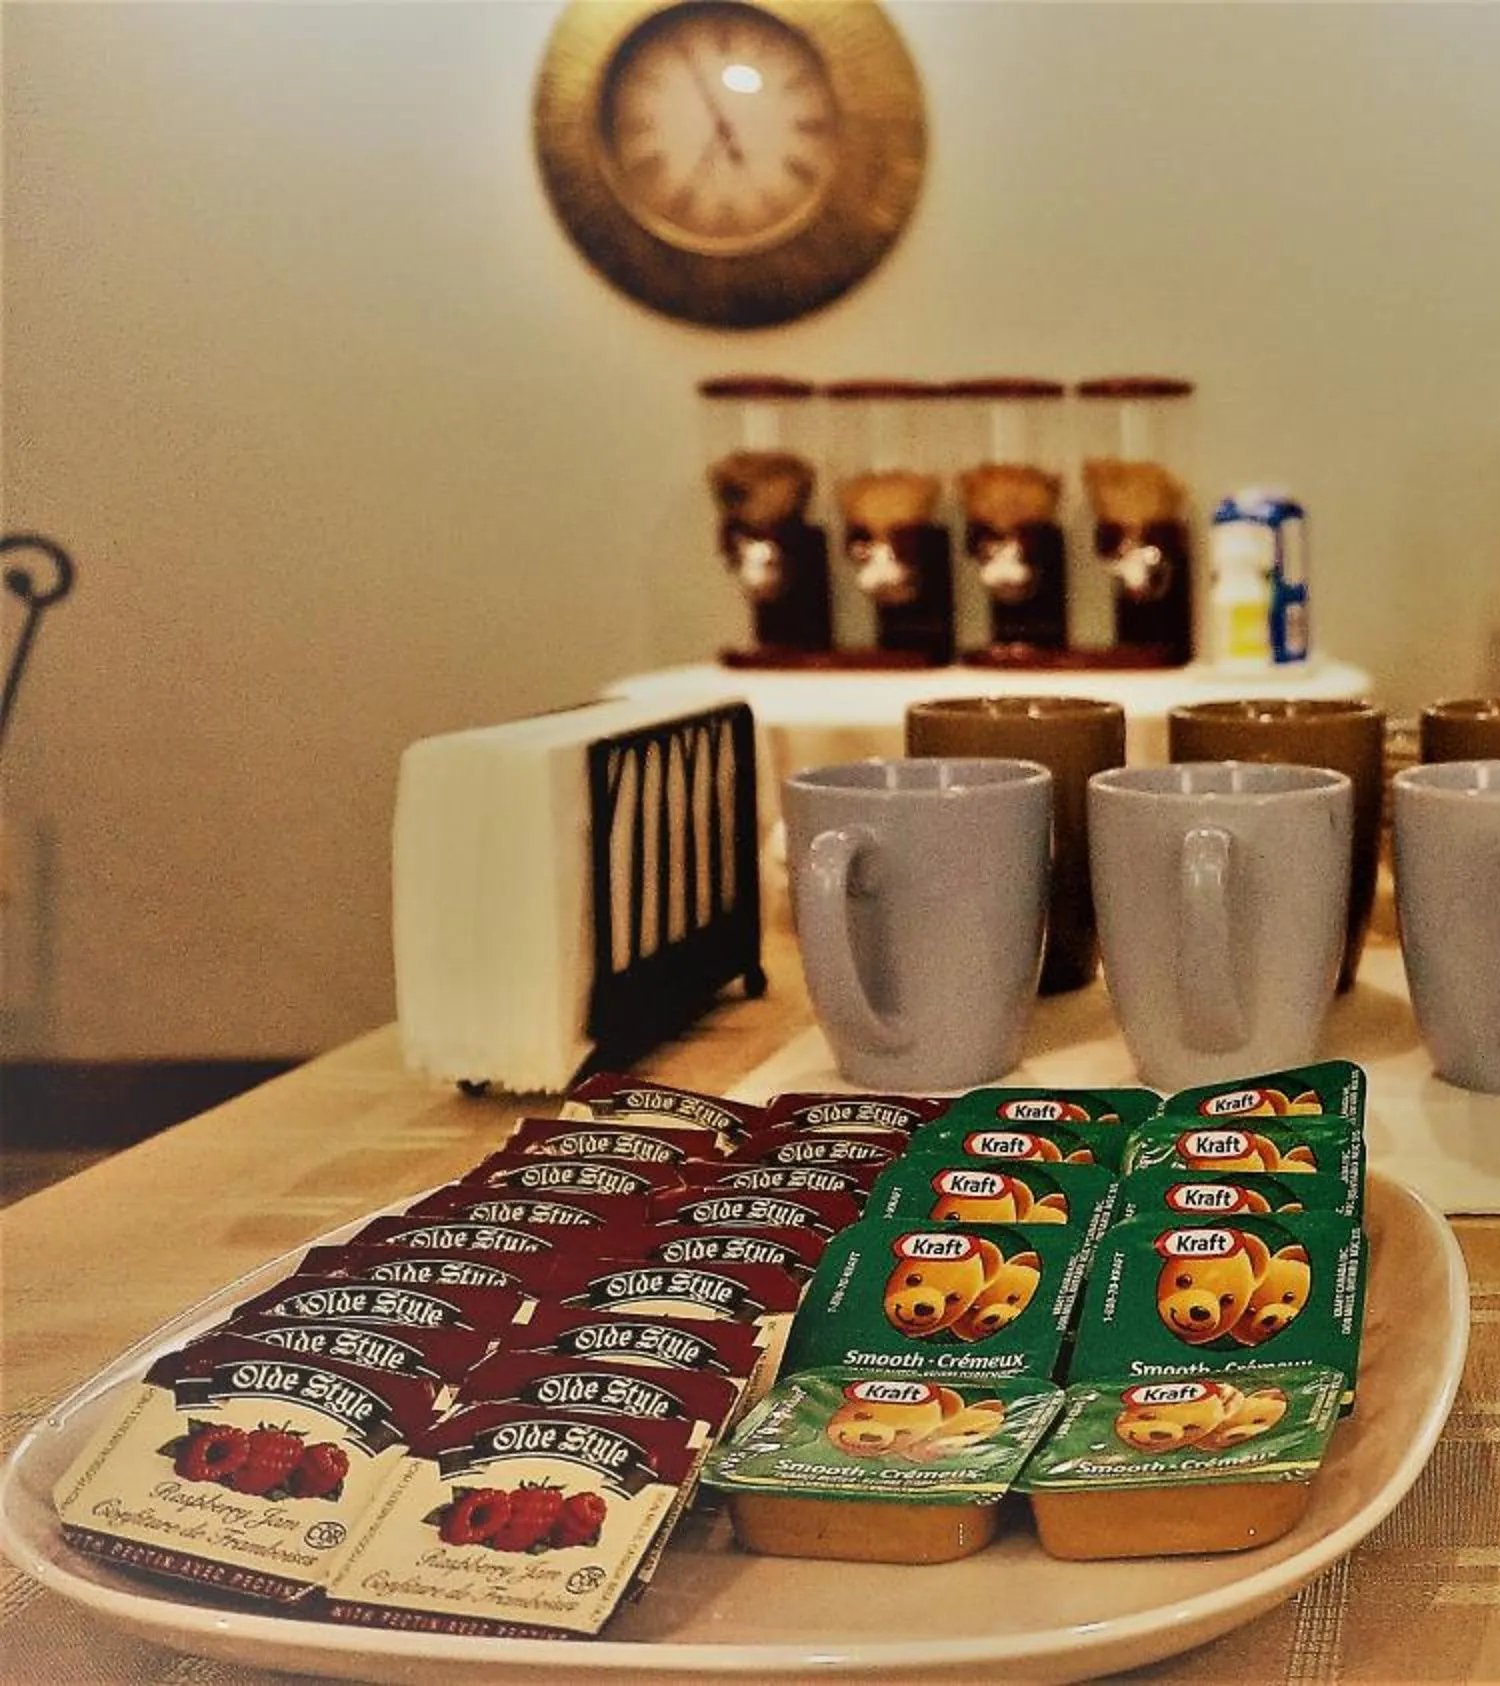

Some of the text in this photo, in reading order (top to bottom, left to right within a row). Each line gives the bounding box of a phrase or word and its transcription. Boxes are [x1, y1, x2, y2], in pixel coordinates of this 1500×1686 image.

[627, 1091, 731, 1129] Olde Style
[1015, 1104, 1056, 1120] Kraft
[1215, 1093, 1255, 1113] Kraft
[806, 1104, 910, 1127] Olde Style
[560, 1133, 670, 1163] Olde Style
[777, 1142, 825, 1164] Olde
[981, 1137, 1025, 1153] Kraft
[1196, 1136, 1241, 1154] Kraft
[521, 1166, 637, 1197] Olde Style
[733, 1170, 784, 1191] Olde
[949, 1176, 997, 1194] Kraft
[1184, 1189, 1232, 1207] Kraft
[470, 1203, 525, 1222] Olde
[693, 1200, 806, 1227] Olde Style
[410, 1229, 467, 1249] Olde
[911, 1238, 963, 1256] Kraft
[1176, 1234, 1227, 1252] Kraft
[663, 1241, 719, 1264] Olde
[371, 1264, 432, 1284] Olde
[606, 1273, 734, 1303] Olde Style
[301, 1290, 444, 1326] Olde Style
[265, 1330, 405, 1370] Olde Style
[574, 1325, 700, 1362] Olde Style
[843, 1350, 925, 1368] Smooth
[937, 1353, 1026, 1370] Crémeux
[232, 1364, 374, 1422] Olde Style
[537, 1379, 670, 1418] Olde Style
[864, 1384, 921, 1401] Kraft
[1143, 1385, 1198, 1402] Kraft
[493, 1426, 630, 1469] Olde Style
[774, 1459, 867, 1477] Smooth
[1078, 1460, 1166, 1474] Smooth
[150, 1481, 301, 1531] Raspberry Jam
